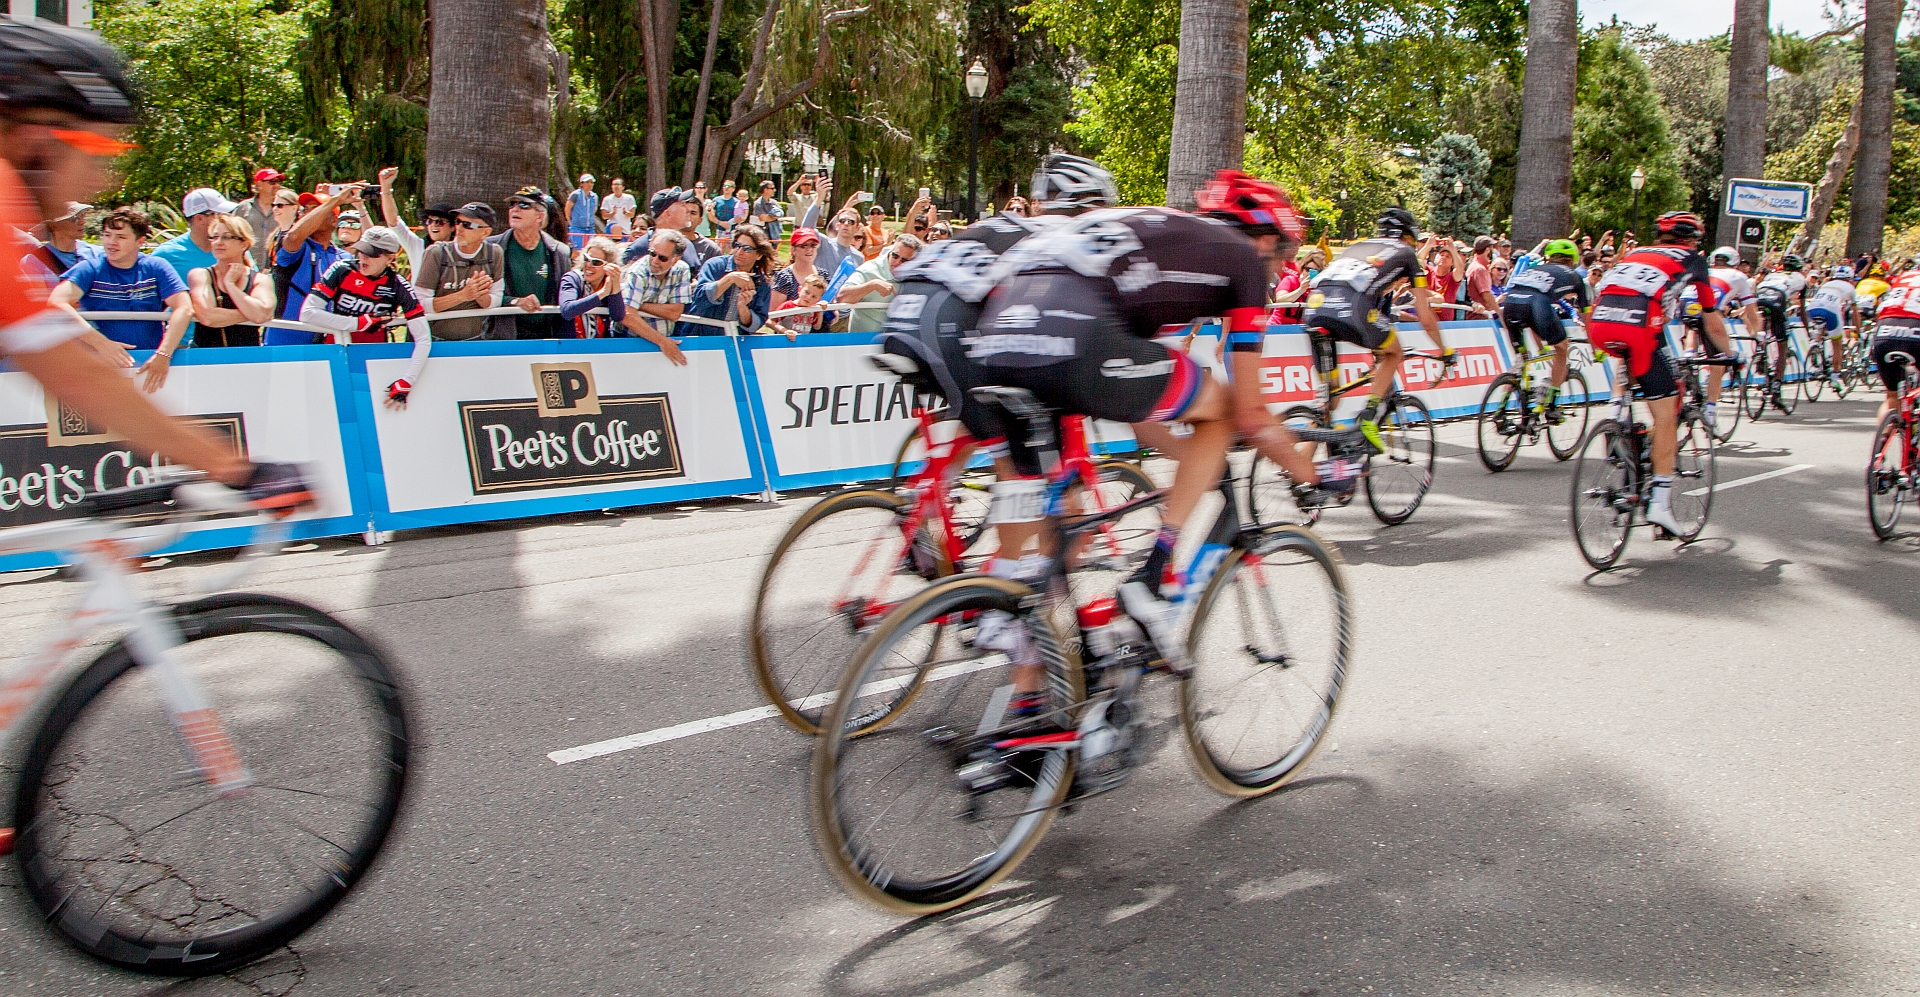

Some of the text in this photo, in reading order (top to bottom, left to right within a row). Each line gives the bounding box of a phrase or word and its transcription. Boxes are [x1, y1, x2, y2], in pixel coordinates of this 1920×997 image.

[1746, 227, 1760, 236] 50
[1635, 267, 1661, 284] 52
[338, 293, 392, 313] BMC
[482, 419, 661, 471] Peet's Coffee
[0, 463, 86, 512] eet's
